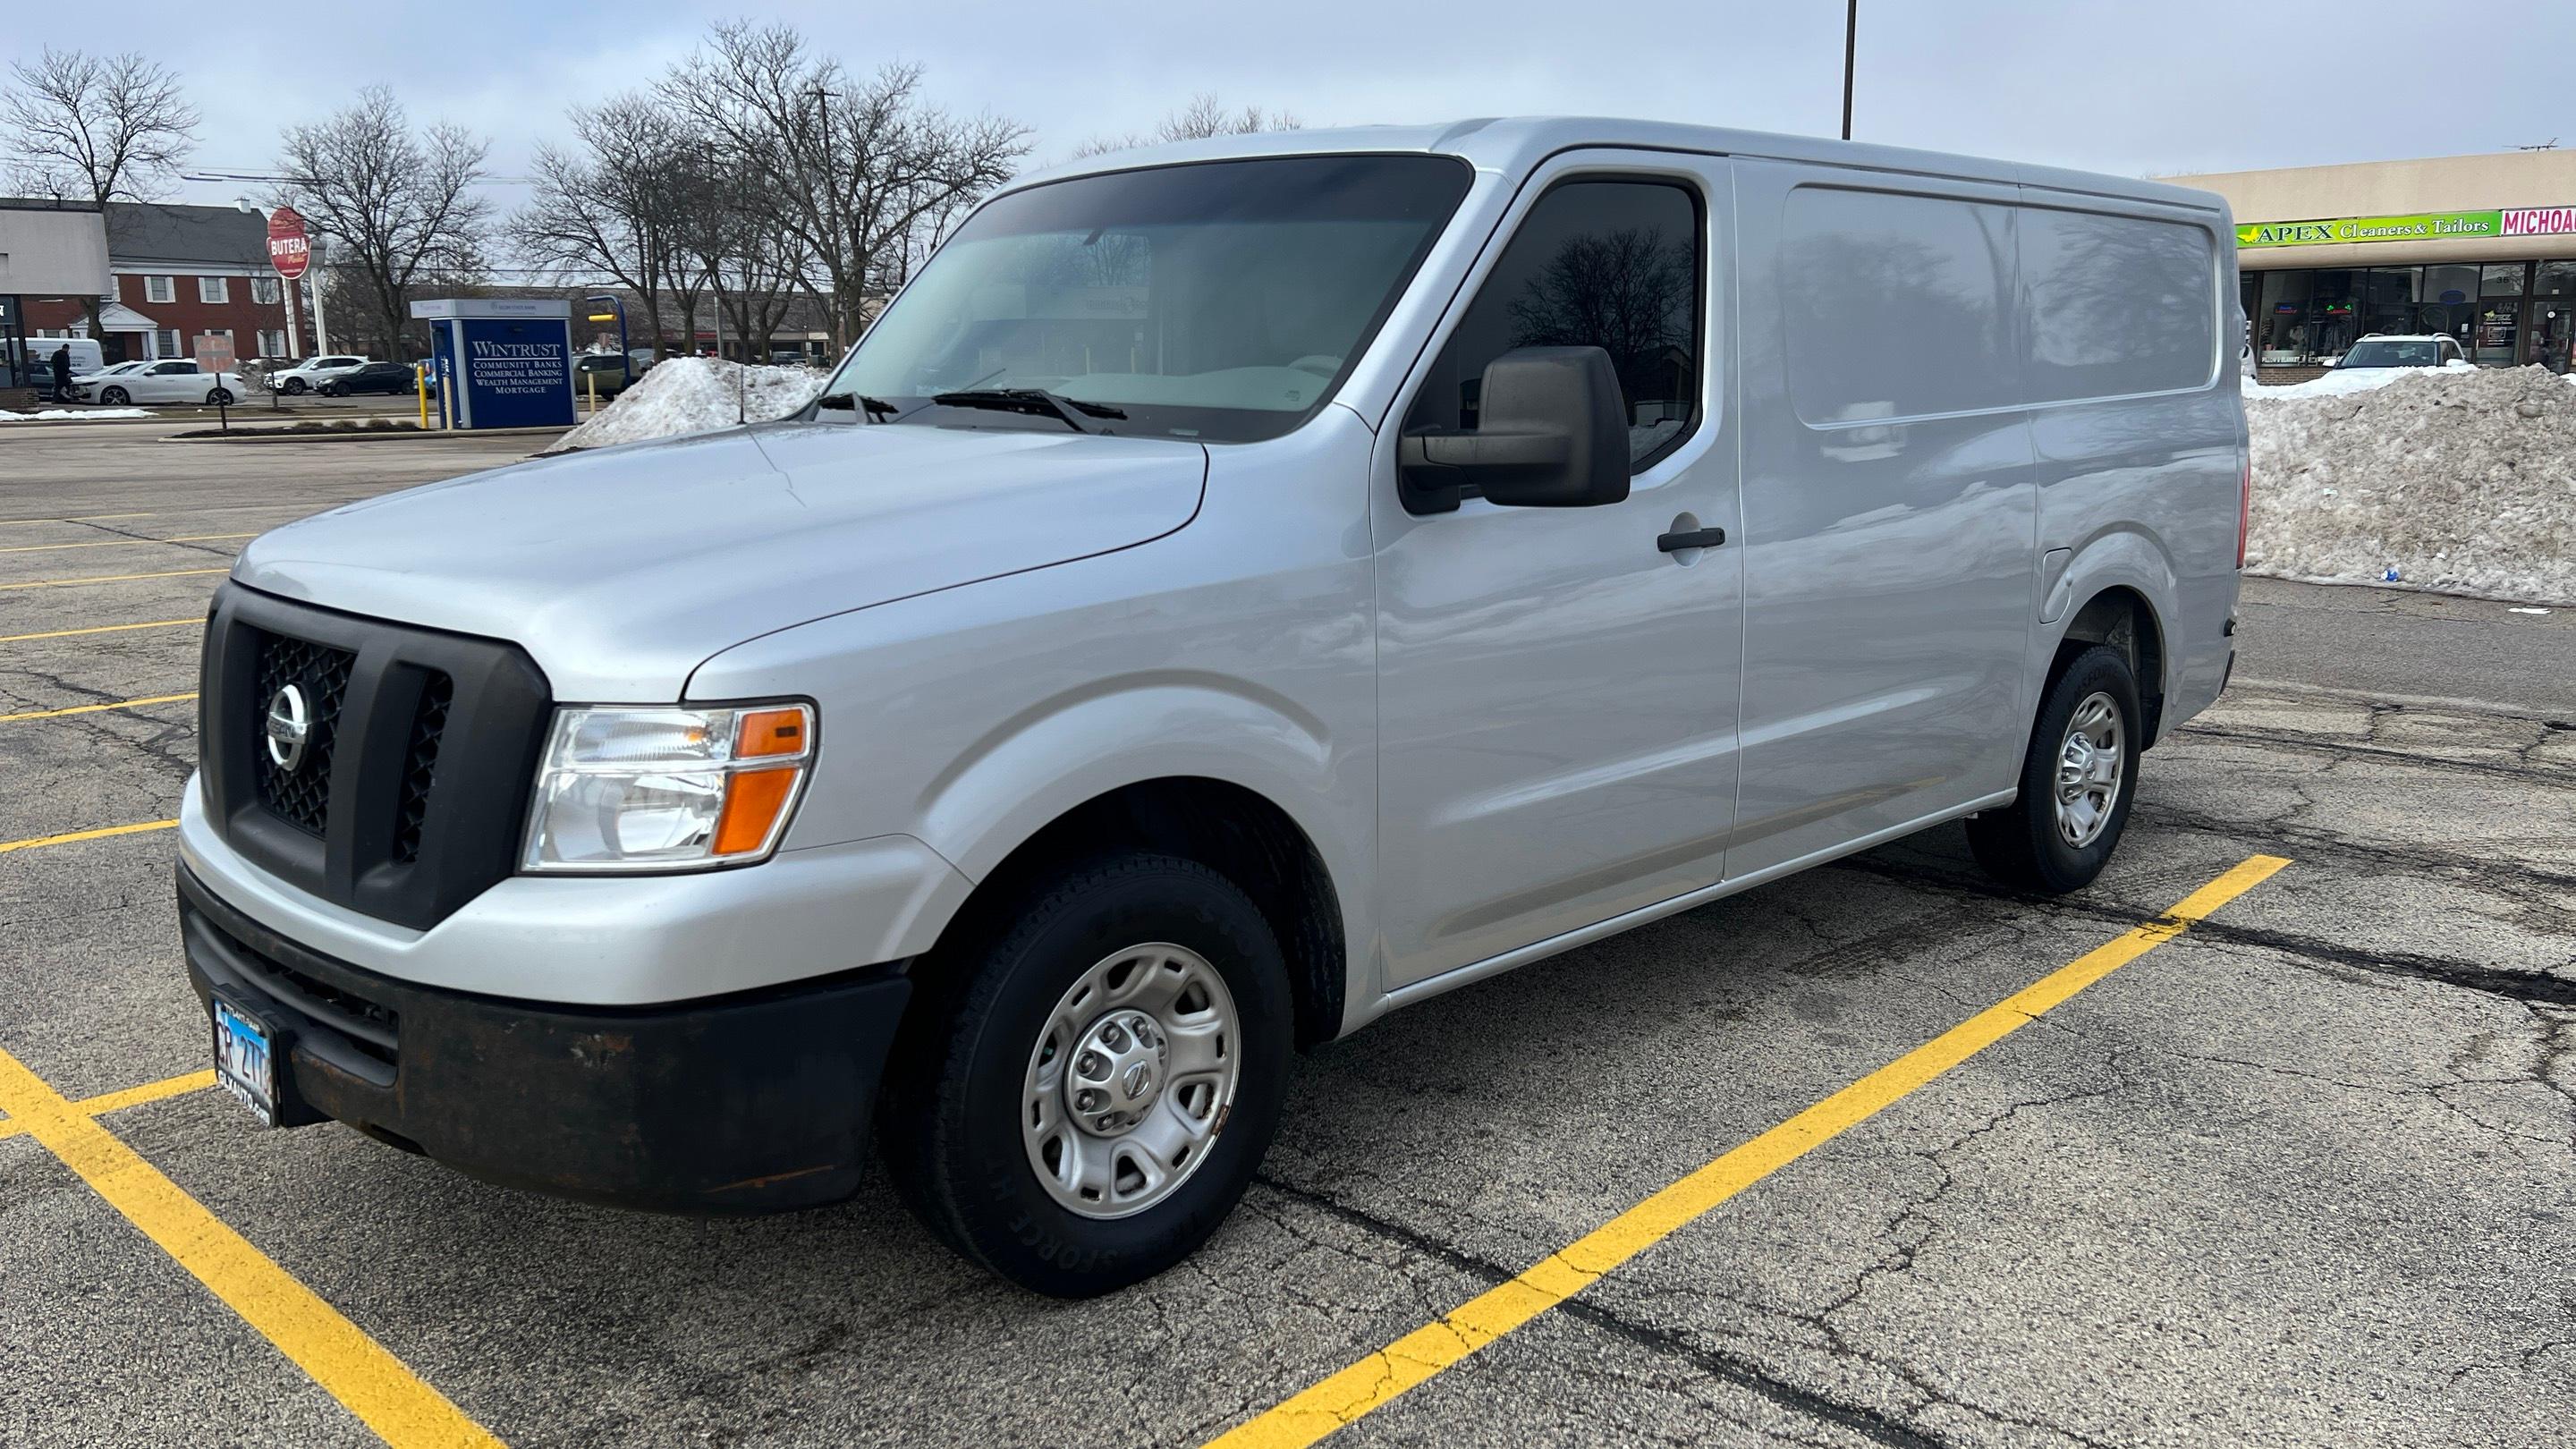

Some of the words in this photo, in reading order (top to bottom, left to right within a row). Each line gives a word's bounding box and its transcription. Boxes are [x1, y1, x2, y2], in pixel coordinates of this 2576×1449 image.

[2504, 209, 2576, 234] MICHOA
[2257, 225, 2334, 243] APEX
[2340, 224, 2411, 239] Cleaners
[2414, 223, 2428, 234] &
[2432, 218, 2489, 233] Tailors
[270, 237, 308, 256] BUTERA
[472, 341, 561, 357] WINTRUST
[473, 361, 530, 369] COMMUNITY
[534, 360, 563, 369] BANKS
[473, 369, 527, 377] COMMERCIAL
[476, 378, 508, 386] WEALTH
[509, 377, 563, 386] MANAGEMENT
[496, 386, 547, 394] MORTGAGE
